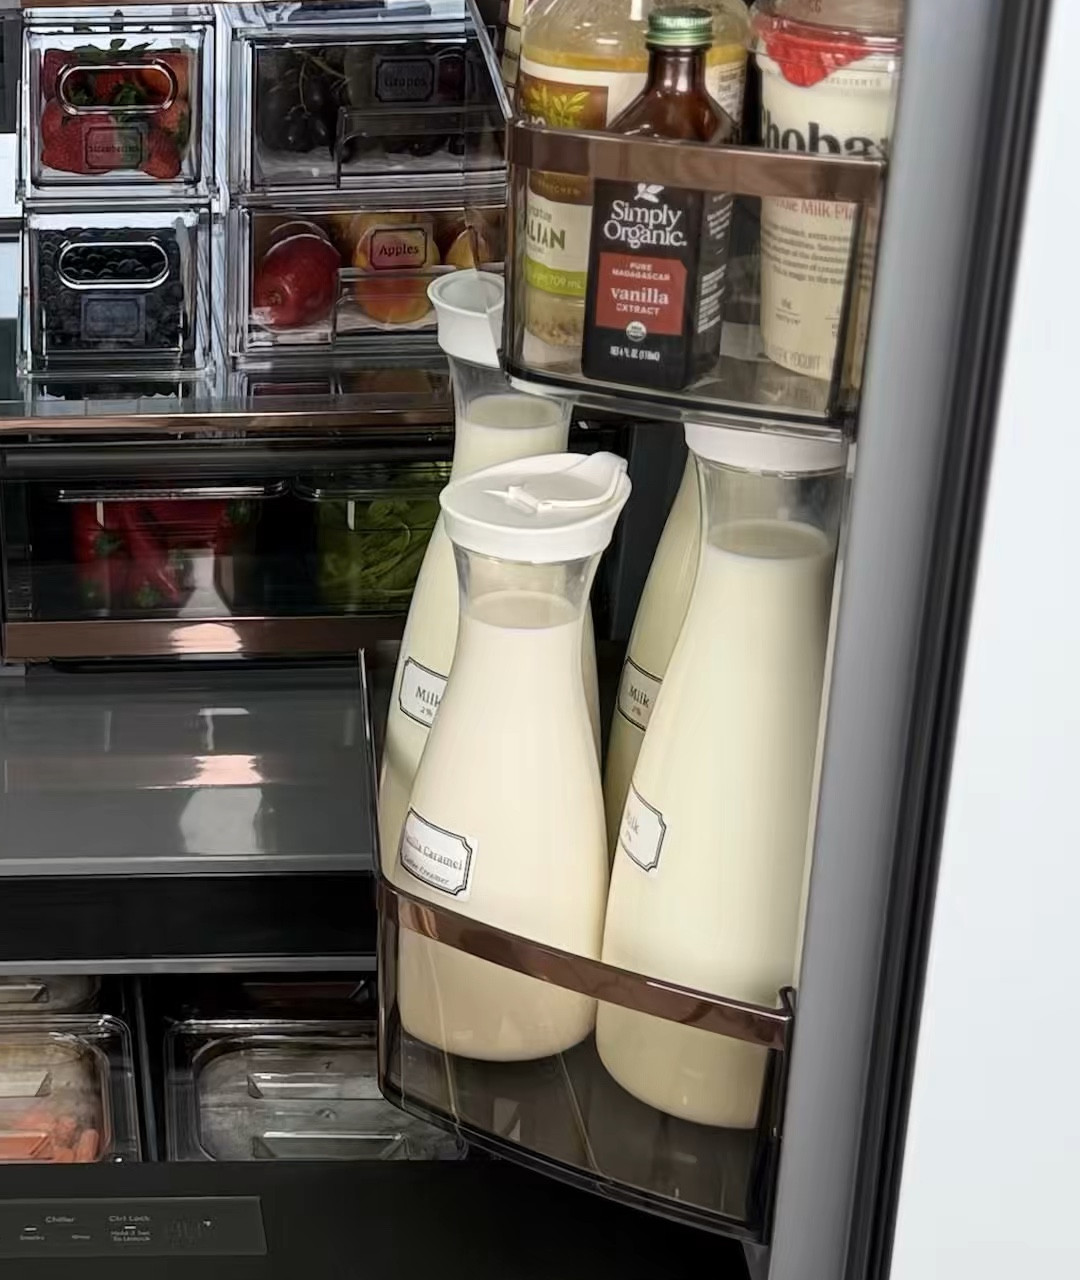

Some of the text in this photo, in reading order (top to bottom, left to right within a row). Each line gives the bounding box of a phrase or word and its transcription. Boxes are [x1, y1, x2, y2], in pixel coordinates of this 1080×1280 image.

[610, 199, 683, 232] Simply
[379, 242, 419, 257] Apples
[629, 261, 653, 271] PURE
[612, 268, 670, 281] MADAGASCAR
[611, 286, 669, 305] vanilla
[616, 302, 660, 316] EXTRACT
